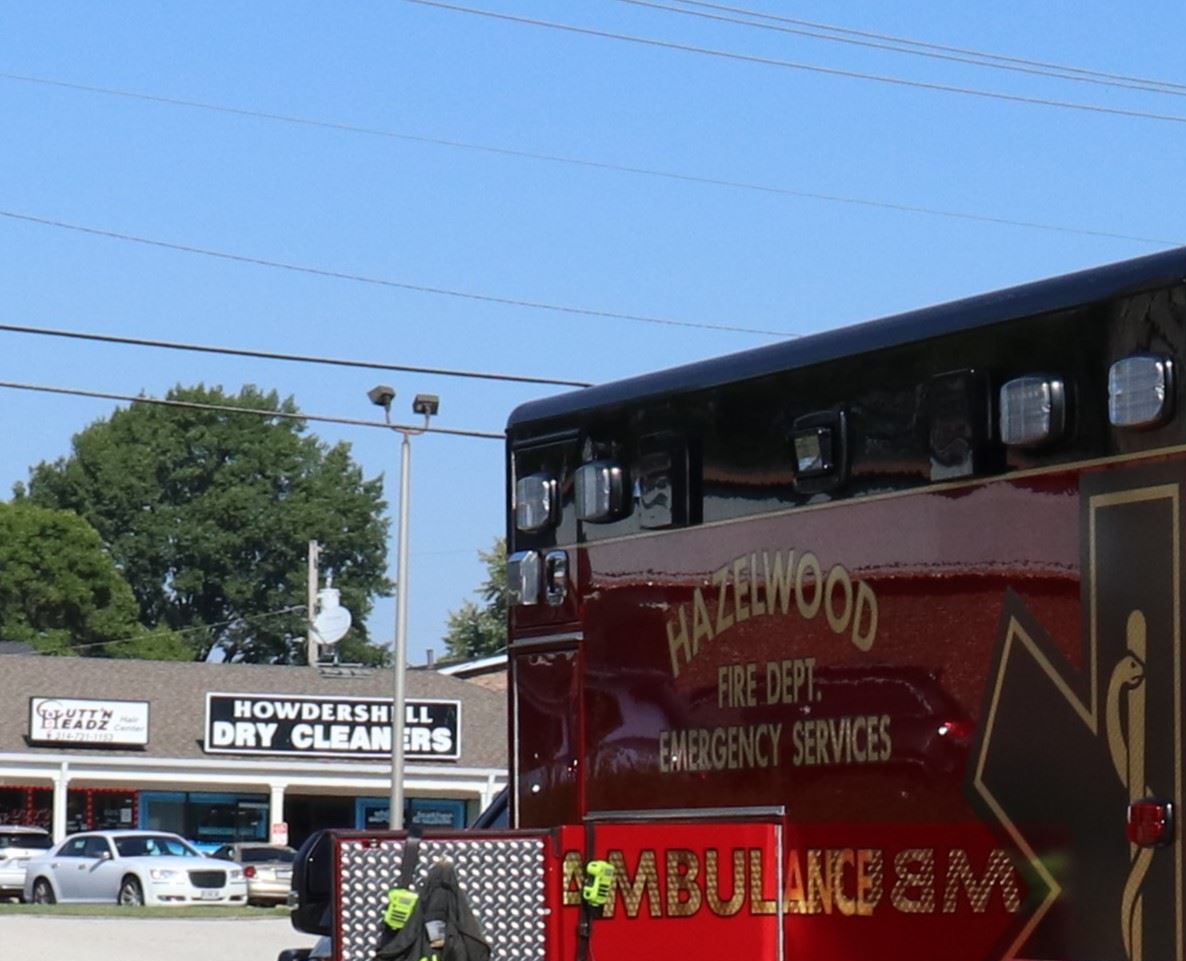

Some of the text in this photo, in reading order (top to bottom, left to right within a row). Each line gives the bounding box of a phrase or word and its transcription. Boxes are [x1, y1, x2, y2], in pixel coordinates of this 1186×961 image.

[666, 548, 880, 678] HAZELWOOD
[718, 657, 823, 709] FIRE DEPT.
[213, 720, 278, 747] DRY
[234, 700, 434, 724] HOWDERSHLL
[660, 715, 892, 774] EMERGENCY SERVICES
[562, 848, 874, 918] AMBULANCE
